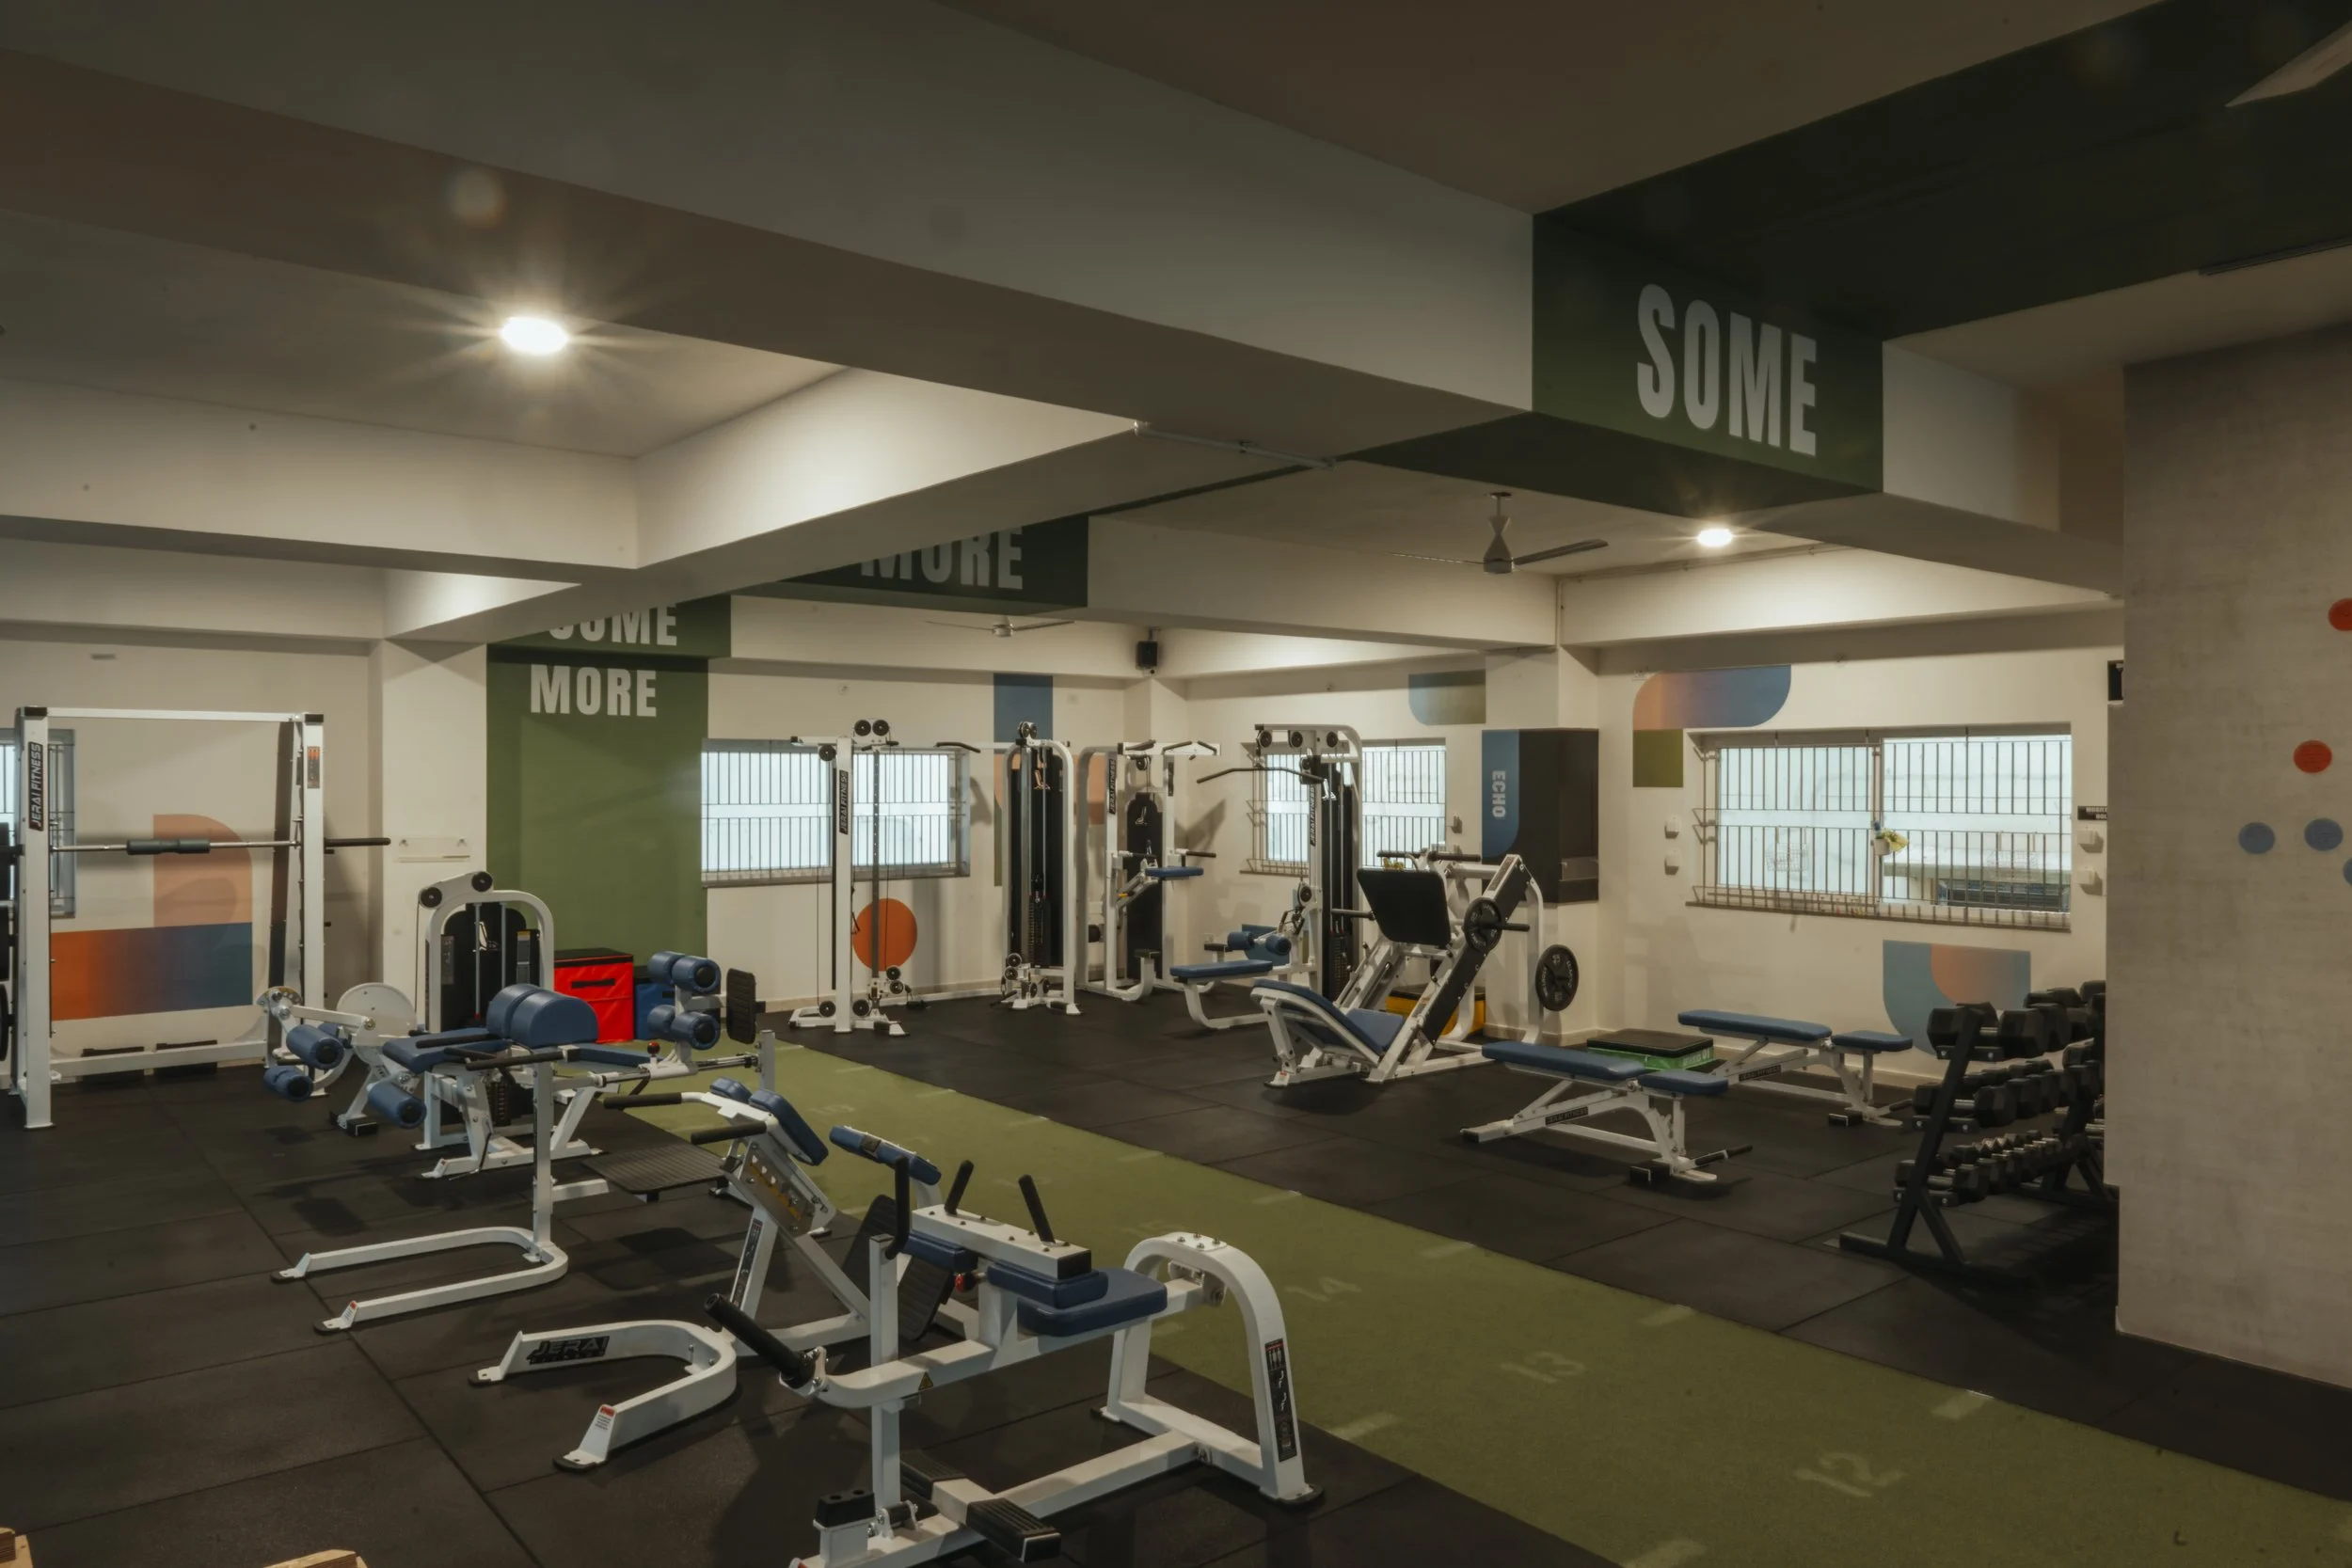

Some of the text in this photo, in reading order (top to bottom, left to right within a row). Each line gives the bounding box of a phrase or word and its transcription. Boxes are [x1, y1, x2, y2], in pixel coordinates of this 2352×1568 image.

[1637, 284, 1817, 456] SOME
[531, 663, 657, 718] MORE
[31, 743, 42, 827] JERAI FITNESS
[1492, 770, 1506, 817] ECHO
[1283, 1275, 1363, 1303] 14
[1499, 1351, 1587, 1385] 13
[1792, 1452, 1909, 1498] 12
